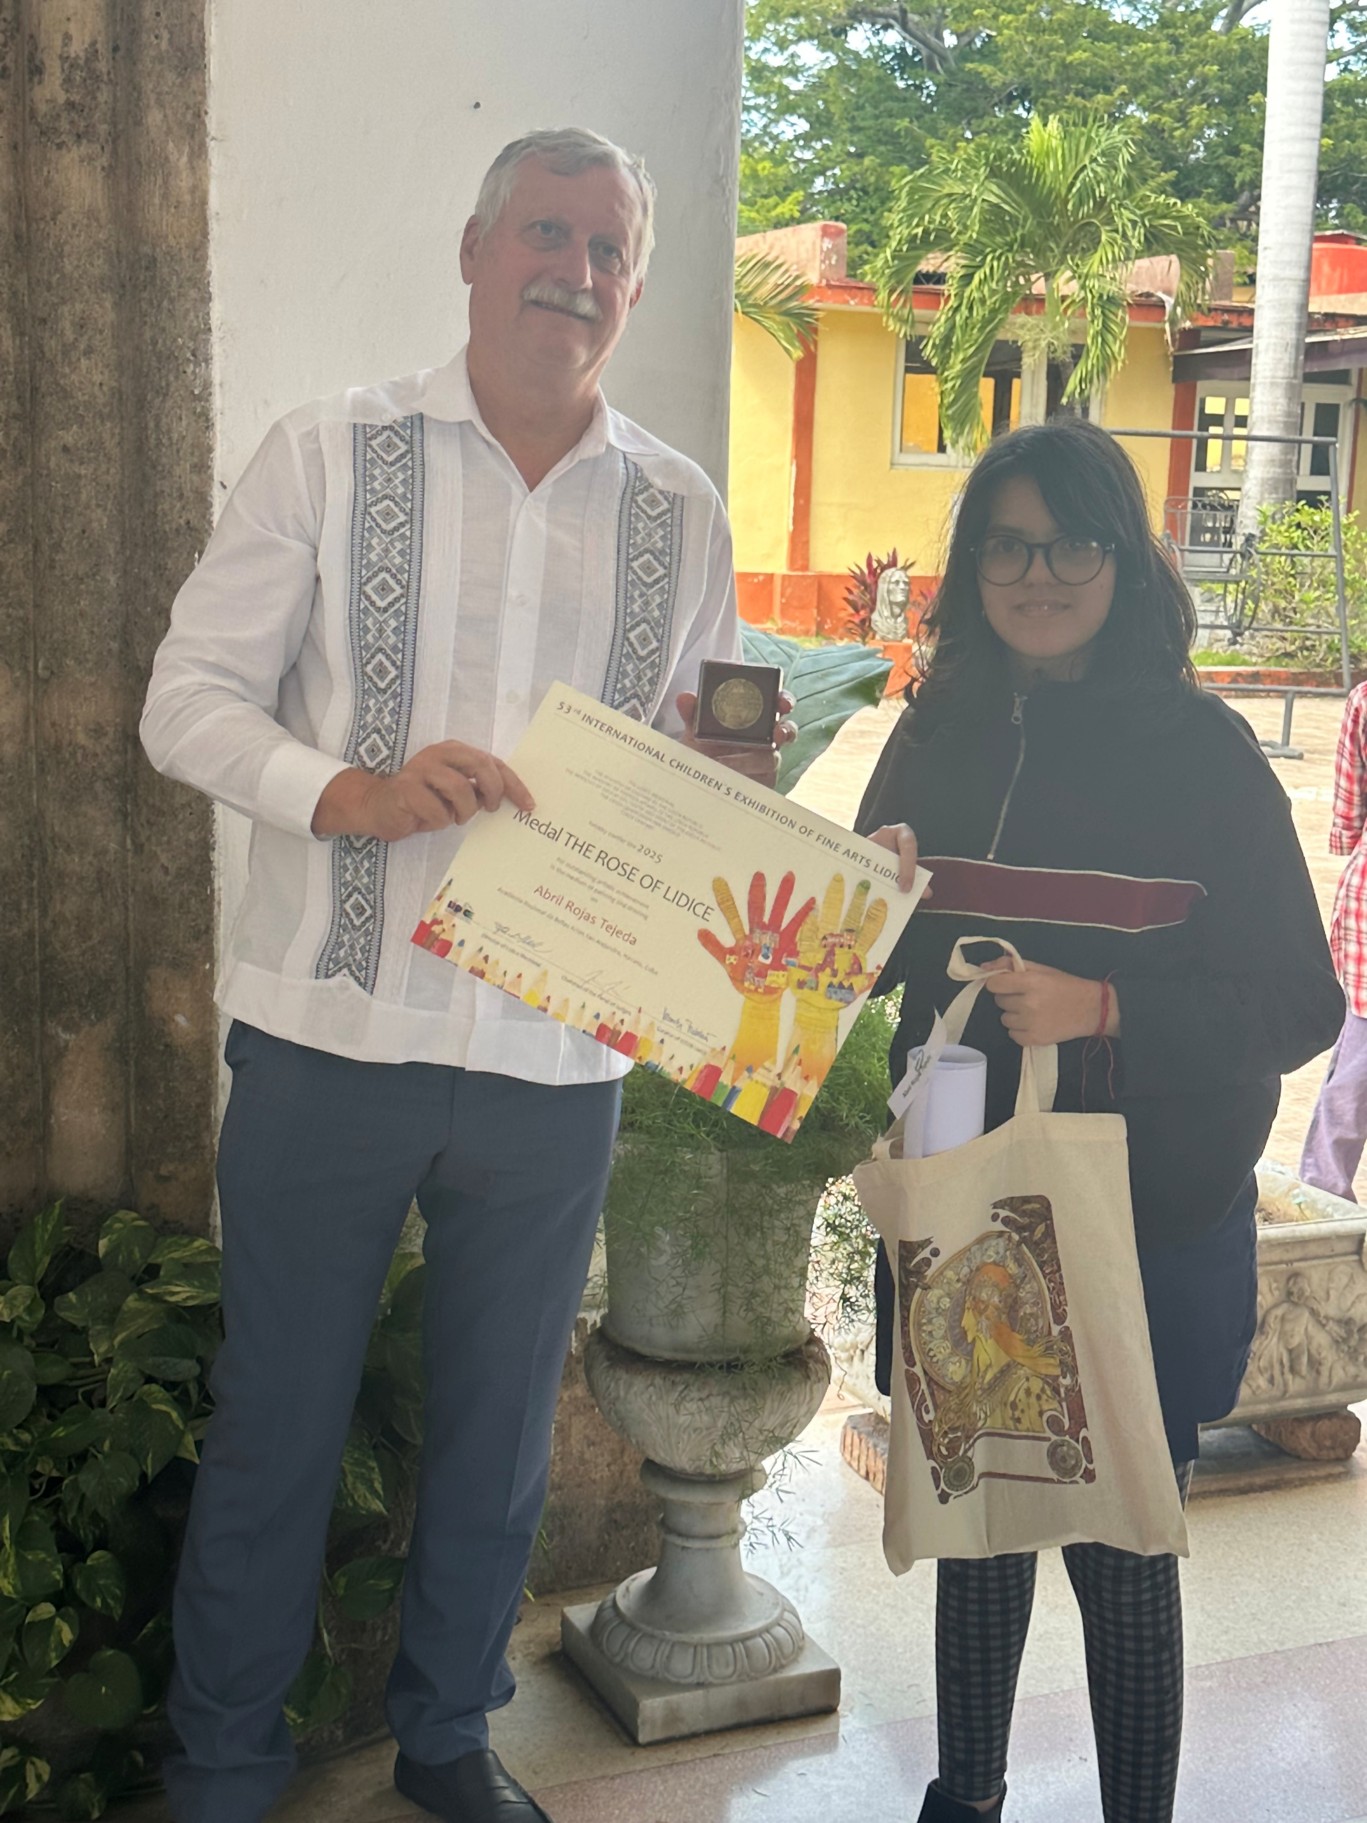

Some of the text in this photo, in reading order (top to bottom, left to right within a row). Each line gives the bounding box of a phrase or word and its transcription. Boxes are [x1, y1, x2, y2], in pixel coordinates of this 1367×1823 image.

[581, 713, 665, 762] INTERNATIONAL
[733, 791, 796, 828] EXHIBITION
[798, 825, 814, 837] OF
[815, 833, 840, 852] FINE
[841, 848, 871, 867] ARTS
[512, 809, 563, 841] Medal
[564, 831, 595, 859] THE
[594, 849, 639, 882] ROSE
[639, 874, 664, 892] OF
[662, 885, 714, 921] LIDICE
[637, 844, 662, 863] 2025
[533, 885, 637, 945] Abril Rojas Tejeda
